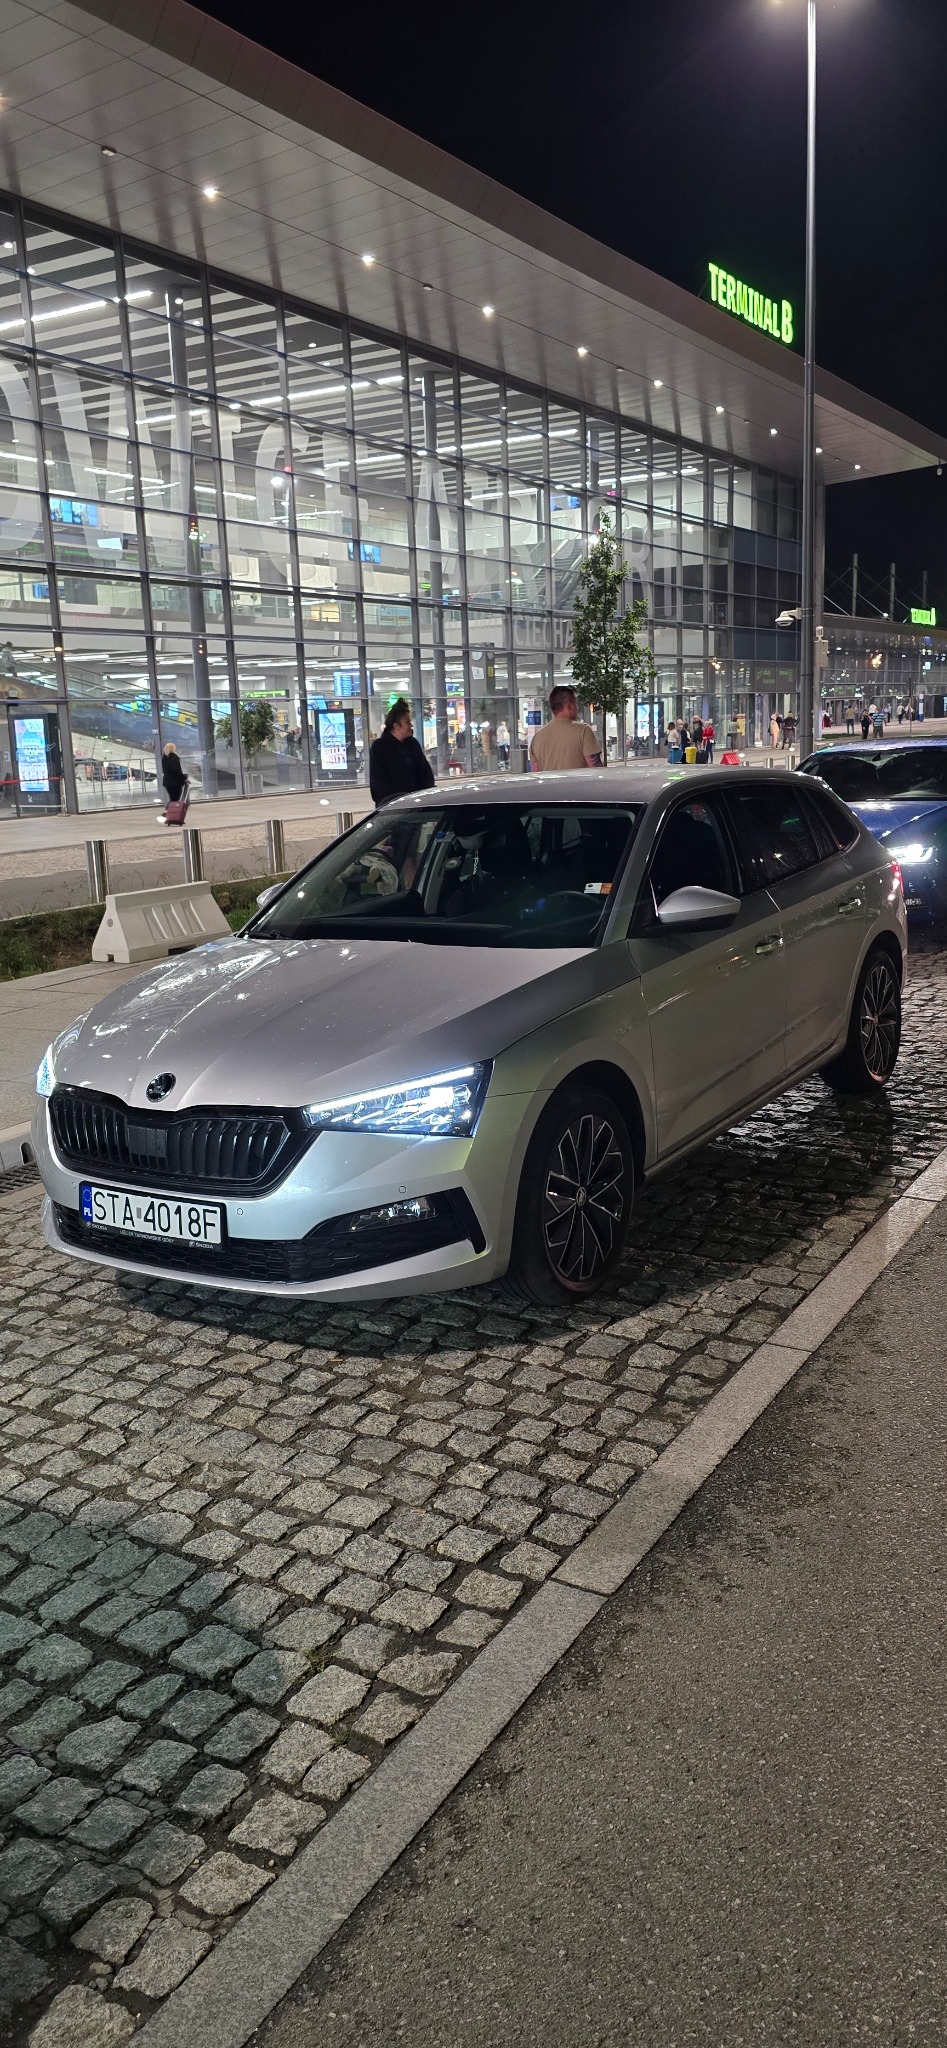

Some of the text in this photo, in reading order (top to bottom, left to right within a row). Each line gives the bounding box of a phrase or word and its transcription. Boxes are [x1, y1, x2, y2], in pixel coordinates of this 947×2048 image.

[708, 262, 793, 344] TERMINAL B
[84, 1207, 92, 1216] PL
[93, 1191, 217, 1239] STA 4018F
